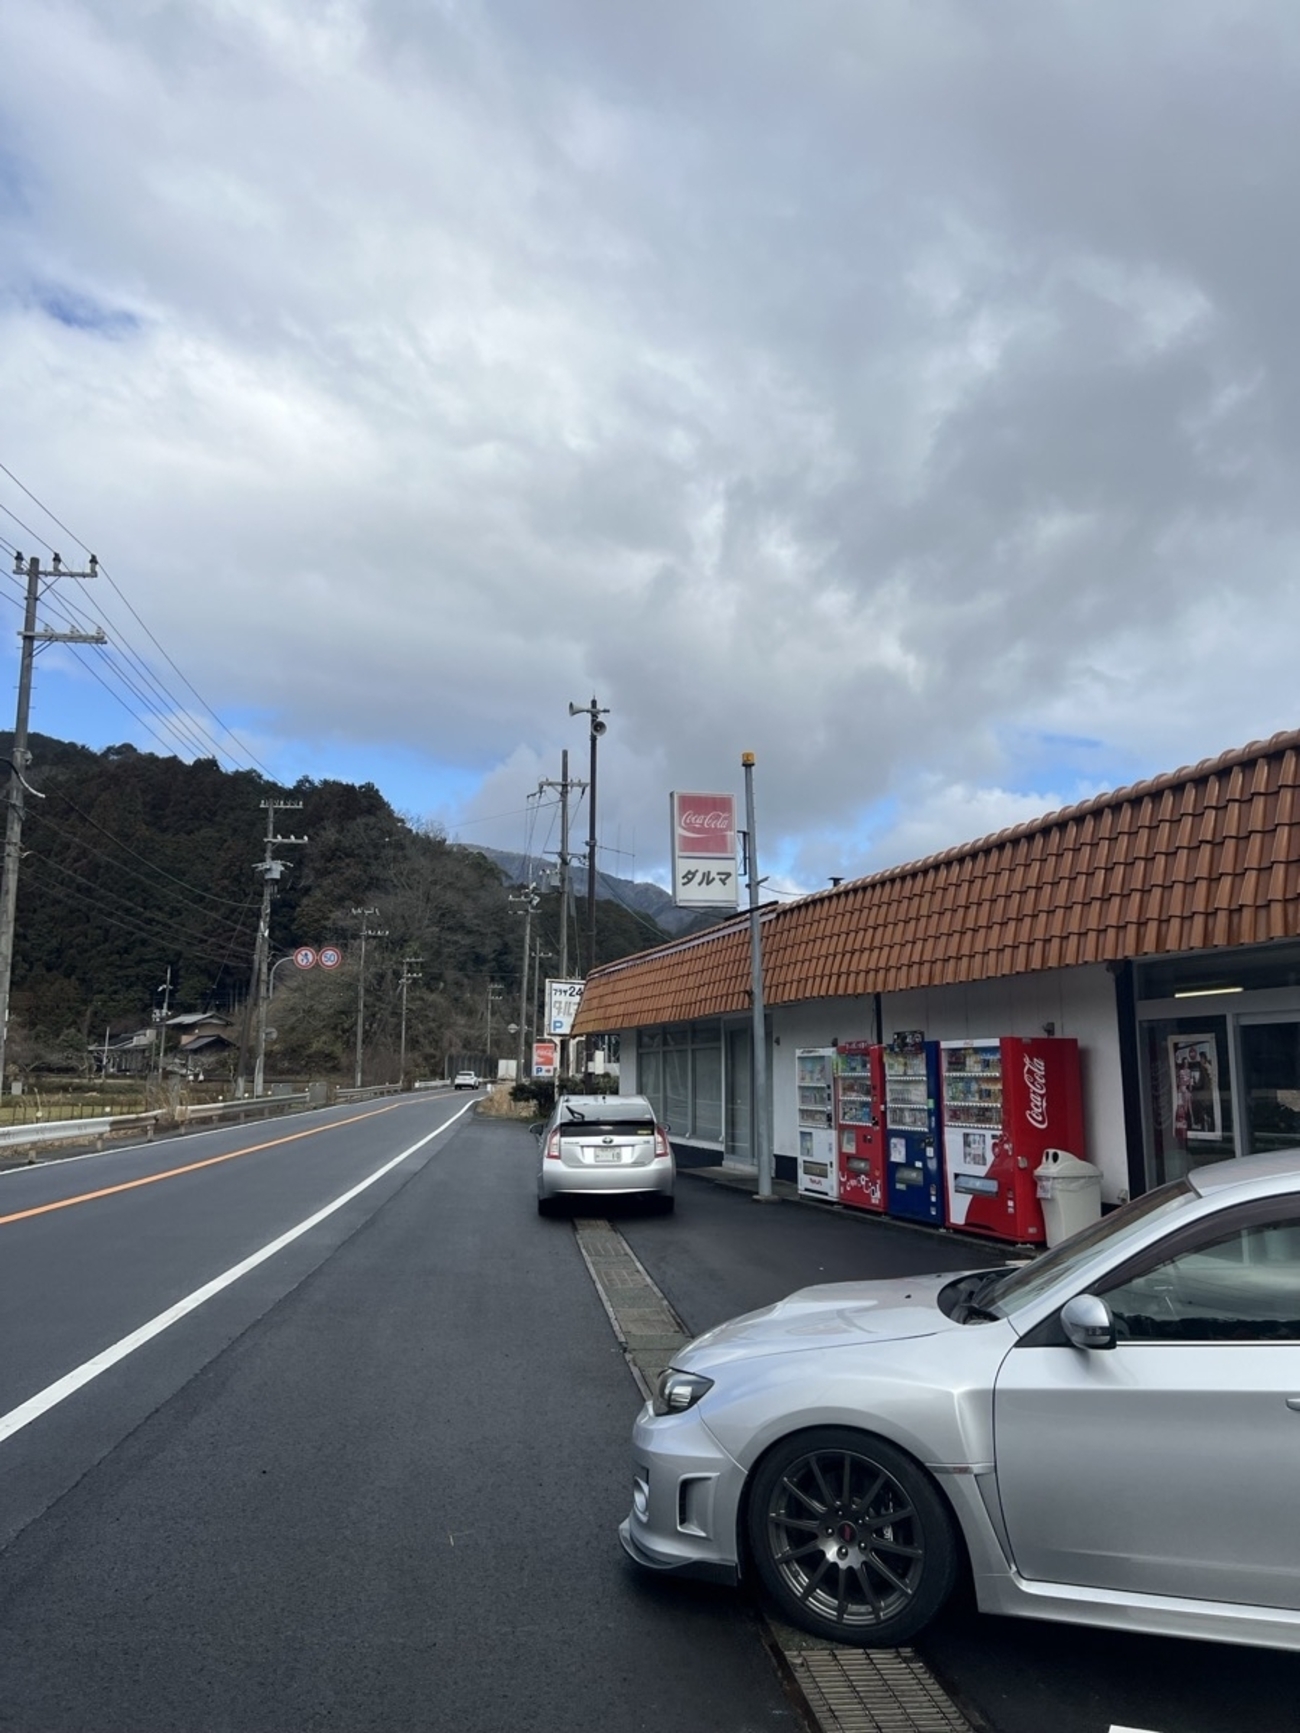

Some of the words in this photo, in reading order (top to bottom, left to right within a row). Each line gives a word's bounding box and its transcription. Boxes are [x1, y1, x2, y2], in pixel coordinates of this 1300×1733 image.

[681, 869, 732, 886] ダルマ
[323, 953, 336, 963] 50
[552, 1020, 564, 1032] P
[535, 1067, 543, 1075] P
[1023, 1053, 1048, 1129] Coca-Cola
